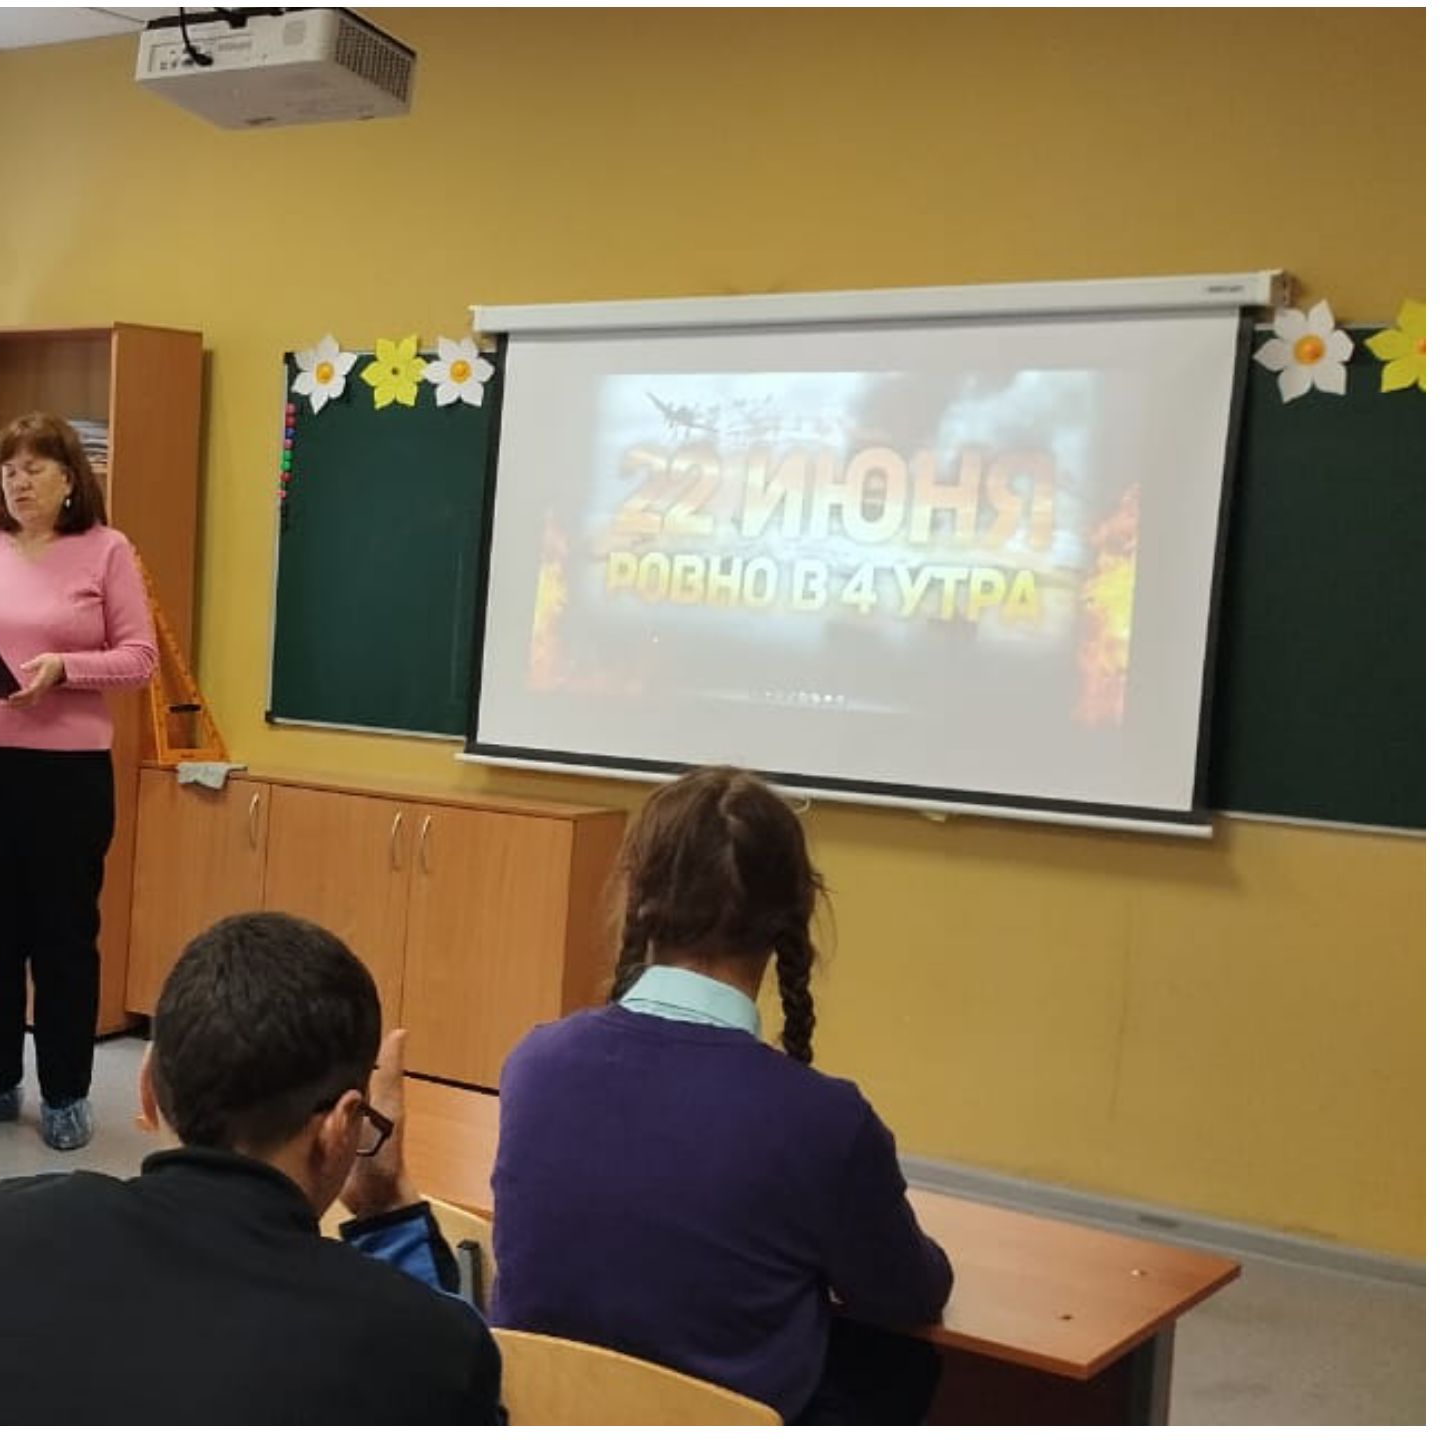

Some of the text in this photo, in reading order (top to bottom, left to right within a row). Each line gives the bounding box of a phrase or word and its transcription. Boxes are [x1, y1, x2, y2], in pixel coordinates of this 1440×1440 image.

[611, 443, 1057, 552] 22 ИЮНЯ
[605, 551, 1044, 623] РОВНО В 4 УТРА
